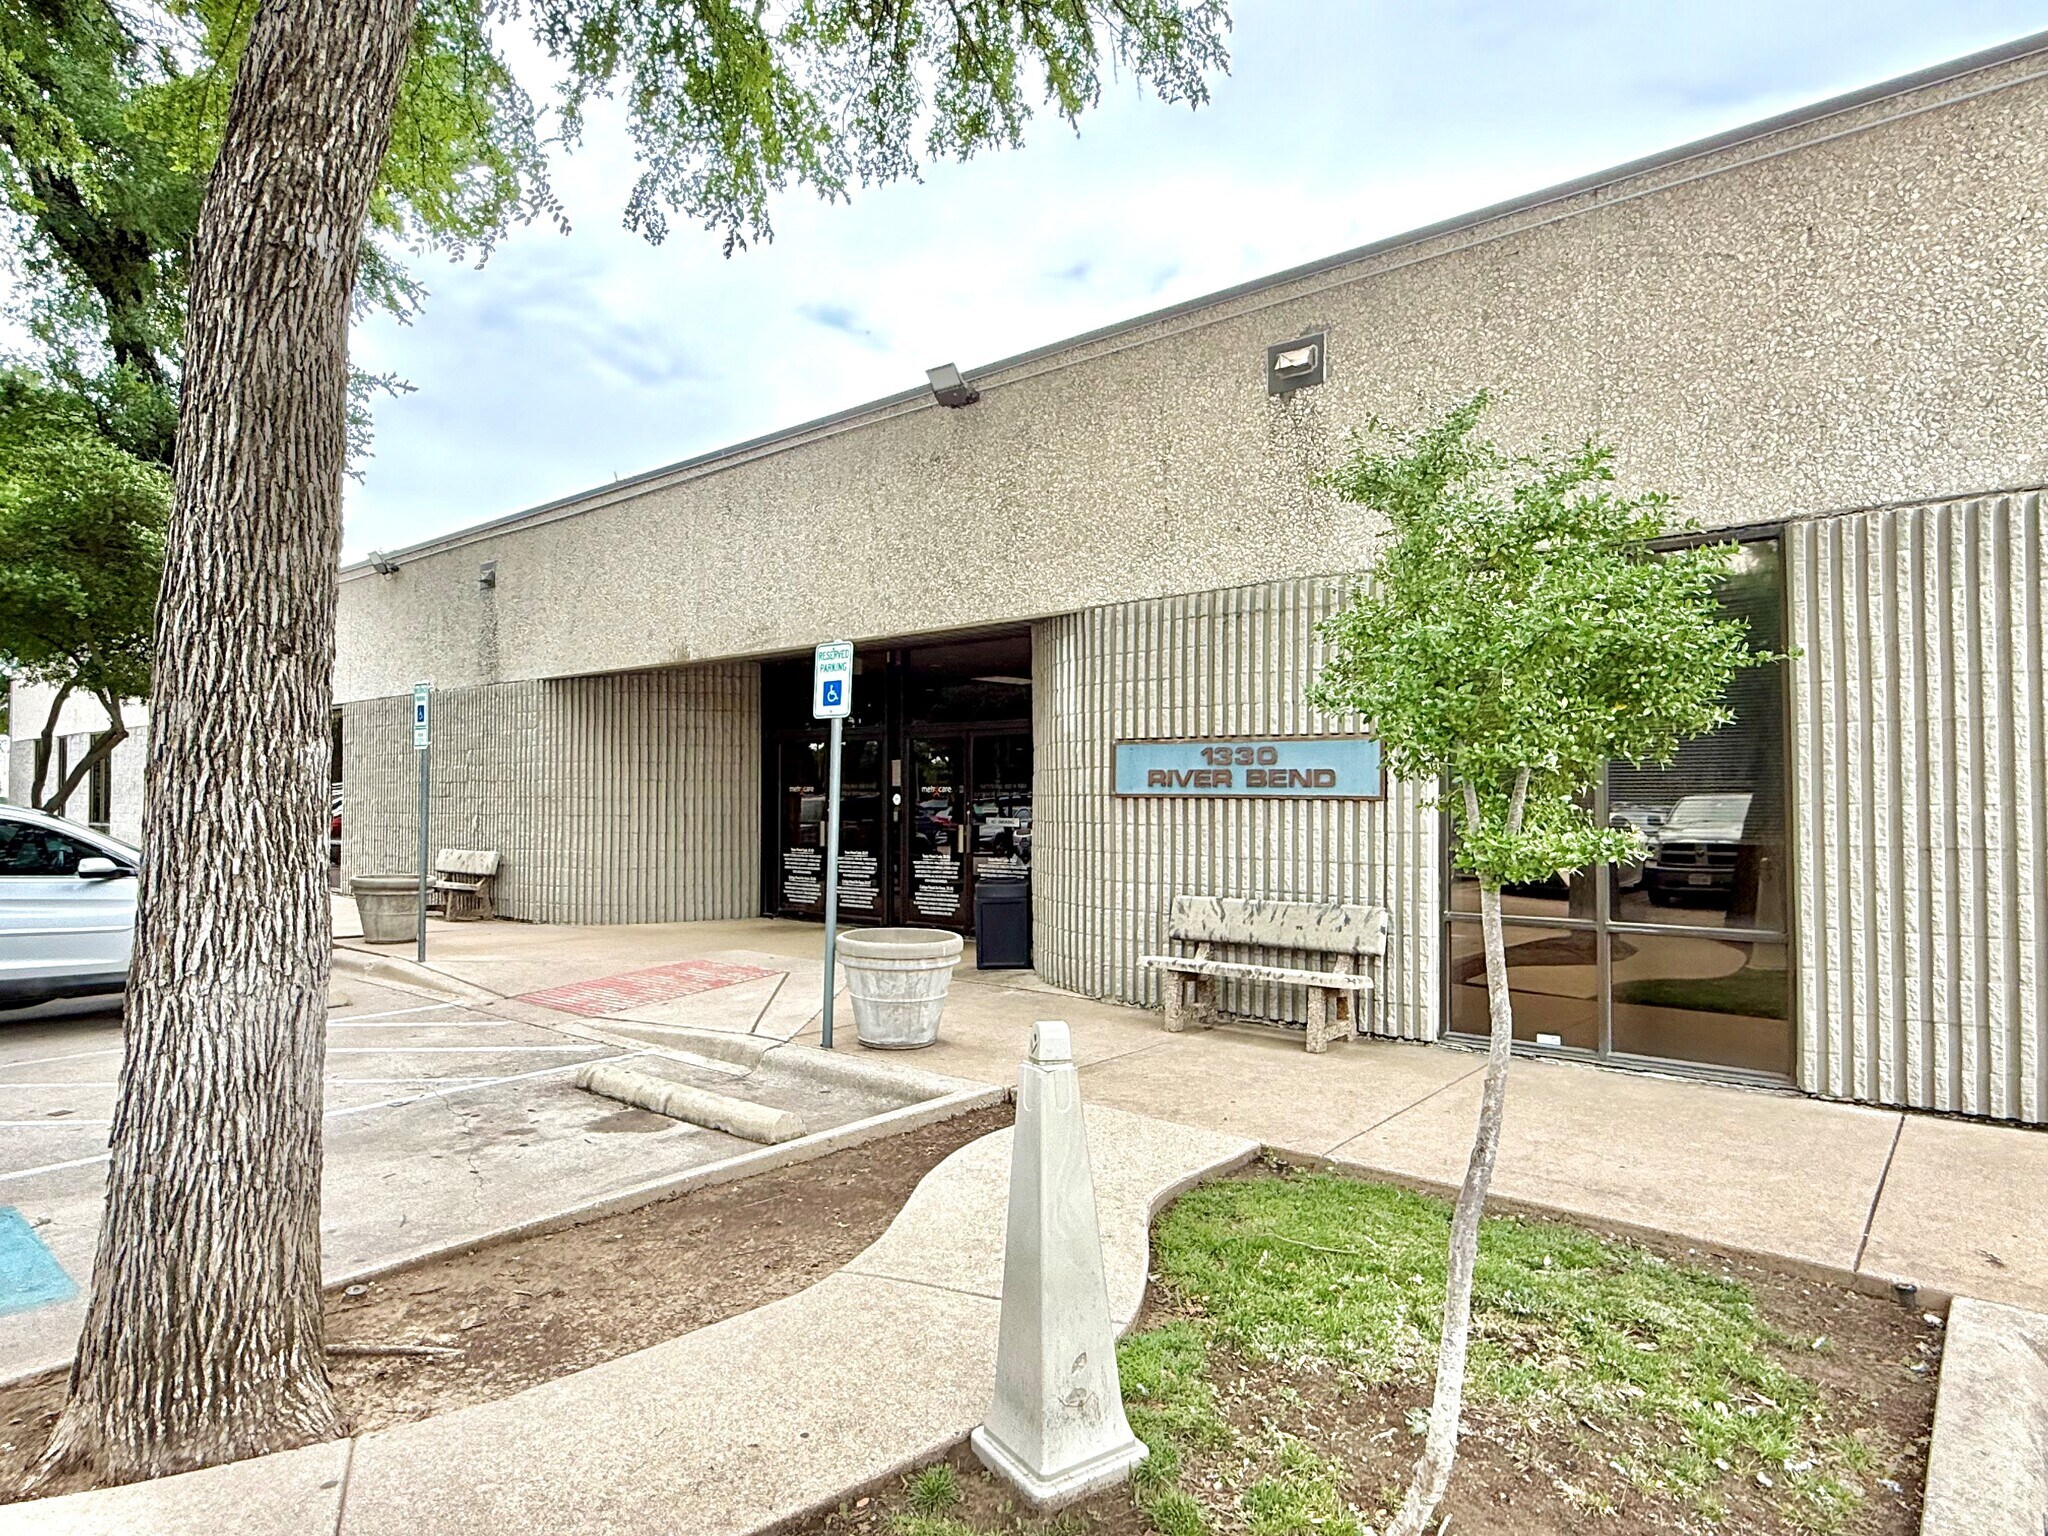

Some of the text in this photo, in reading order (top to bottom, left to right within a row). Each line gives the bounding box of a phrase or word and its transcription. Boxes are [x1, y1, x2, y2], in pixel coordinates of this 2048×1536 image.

[819, 650, 849, 660] RESERVED
[820, 662, 847, 672] PARKING
[1200, 746, 1278, 766] 1330
[1147, 769, 1336, 788] RIVER BEND
